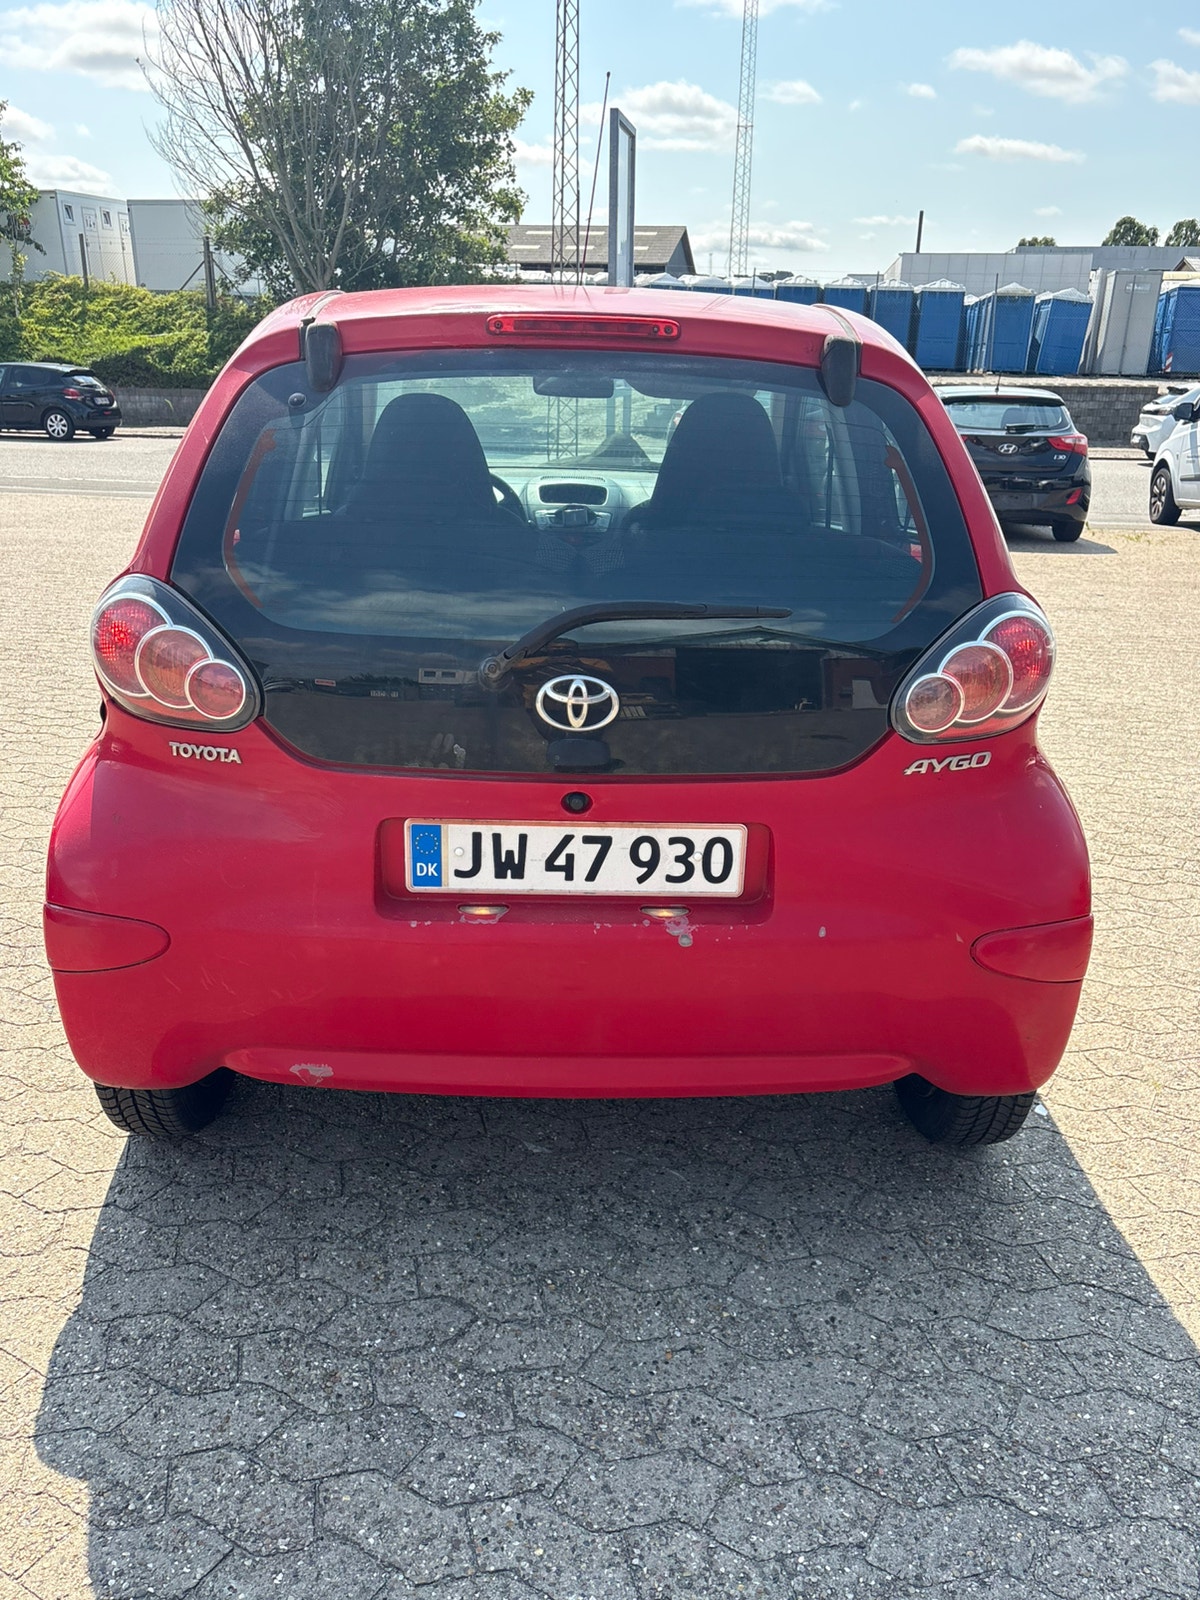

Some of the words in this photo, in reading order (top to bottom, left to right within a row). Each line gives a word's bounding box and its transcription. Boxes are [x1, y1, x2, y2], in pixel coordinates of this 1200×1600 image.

[168, 741, 242, 764] TOYOTA
[903, 751, 992, 775] AYGO
[416, 862, 438, 877] DK
[453, 831, 528, 880] JW
[544, 833, 614, 882] 47
[628, 836, 735, 885] 930
